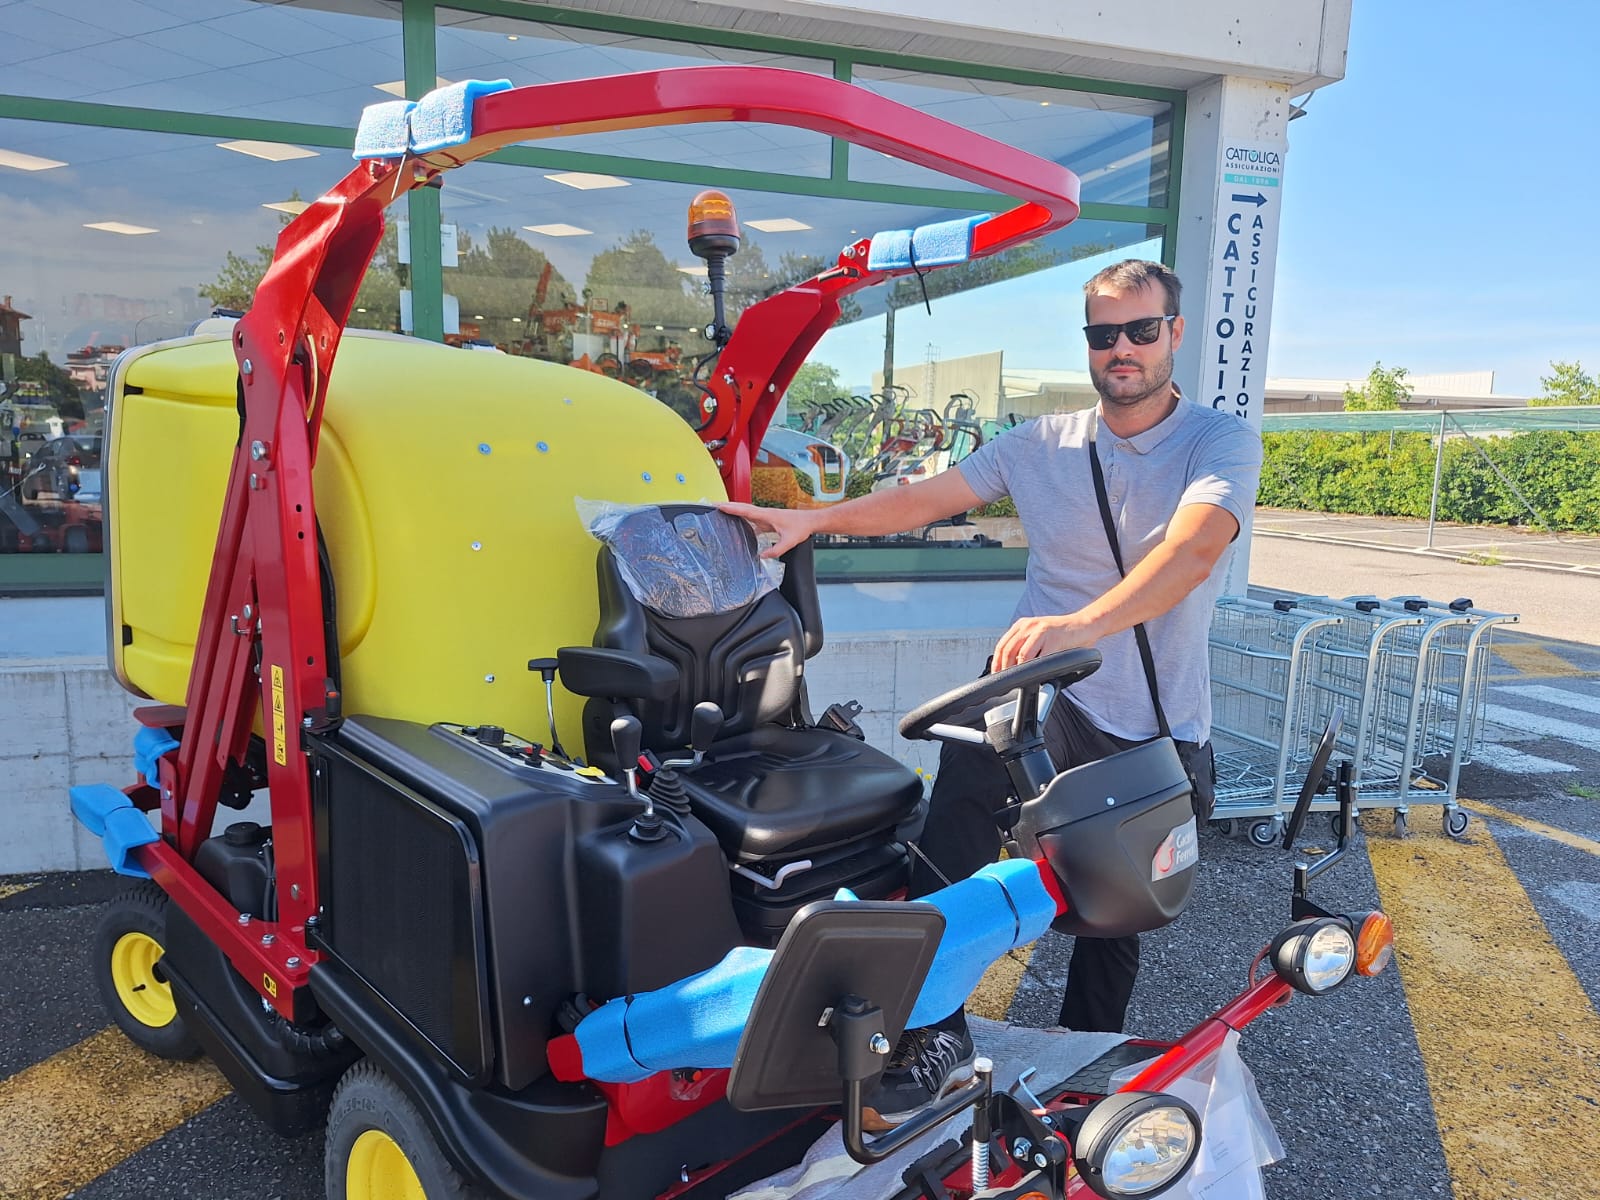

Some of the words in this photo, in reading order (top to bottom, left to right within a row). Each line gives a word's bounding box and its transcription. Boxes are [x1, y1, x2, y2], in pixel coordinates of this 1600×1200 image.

[1225, 147, 1280, 165] CATTOLICA
[1225, 163, 1280, 173] ASSICURAZIONI
[1212, 213, 1242, 412] CATTOLIC
[1236, 214, 1263, 419] ASSICURAZION
